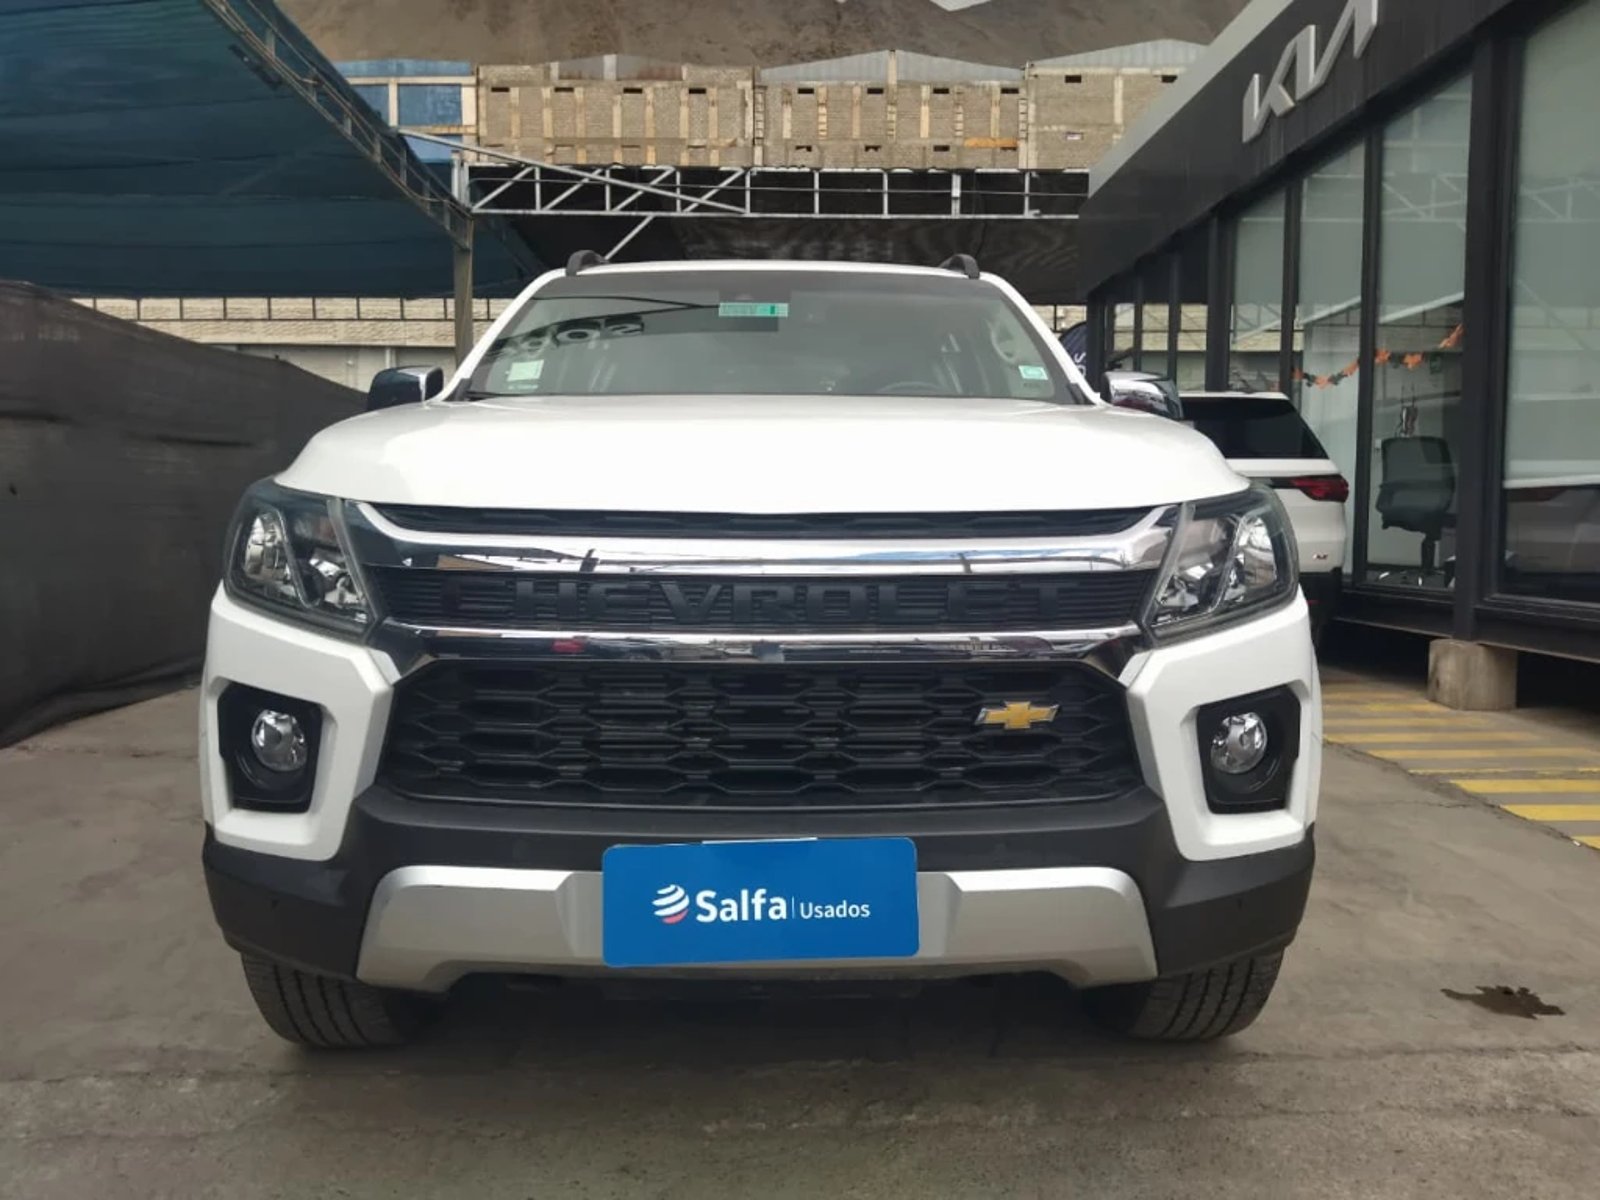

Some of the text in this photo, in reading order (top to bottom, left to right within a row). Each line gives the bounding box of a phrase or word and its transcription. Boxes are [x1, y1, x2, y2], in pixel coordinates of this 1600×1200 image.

[440, 579, 1081, 624] CHEVROLET
[695, 888, 871, 922] Salfa Usados
